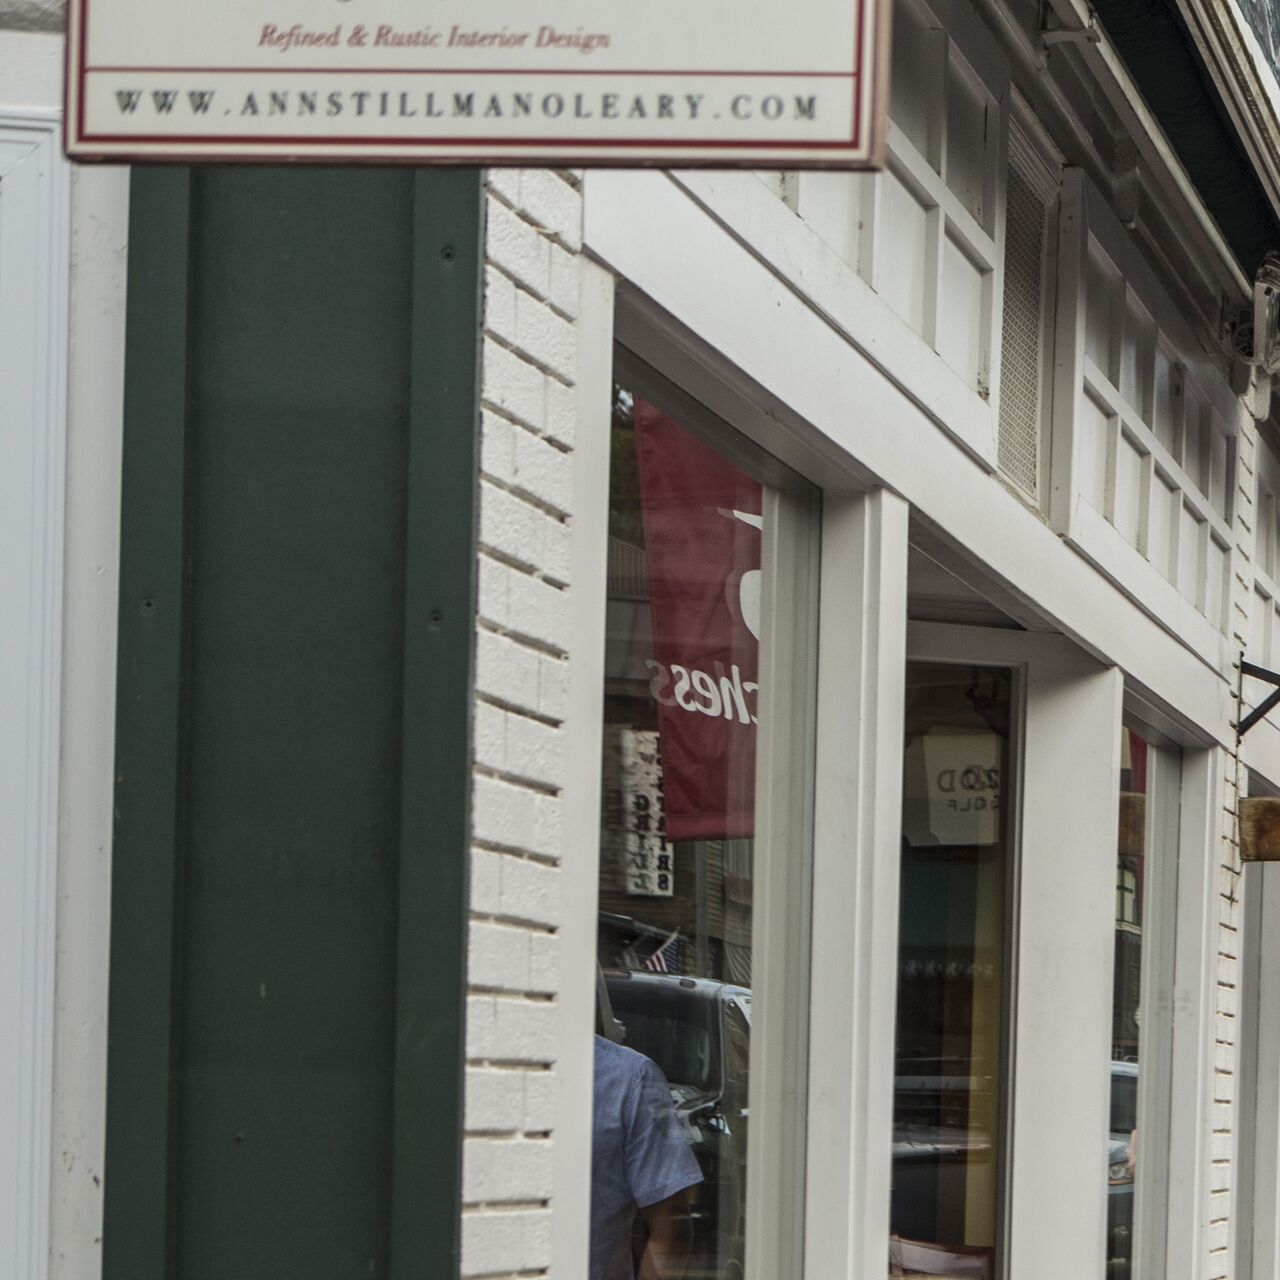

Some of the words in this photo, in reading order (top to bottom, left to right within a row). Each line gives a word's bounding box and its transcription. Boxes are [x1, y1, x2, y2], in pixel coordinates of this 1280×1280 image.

[257, 24, 343, 53] Refined
[346, 24, 370, 48] &
[373, 24, 443, 48] Rustic
[447, 24, 531, 48] Interior
[535, 25, 611, 54] Design
[114, 89, 818, 120] WWW.ANNSTILLMANOLEARY.COM
